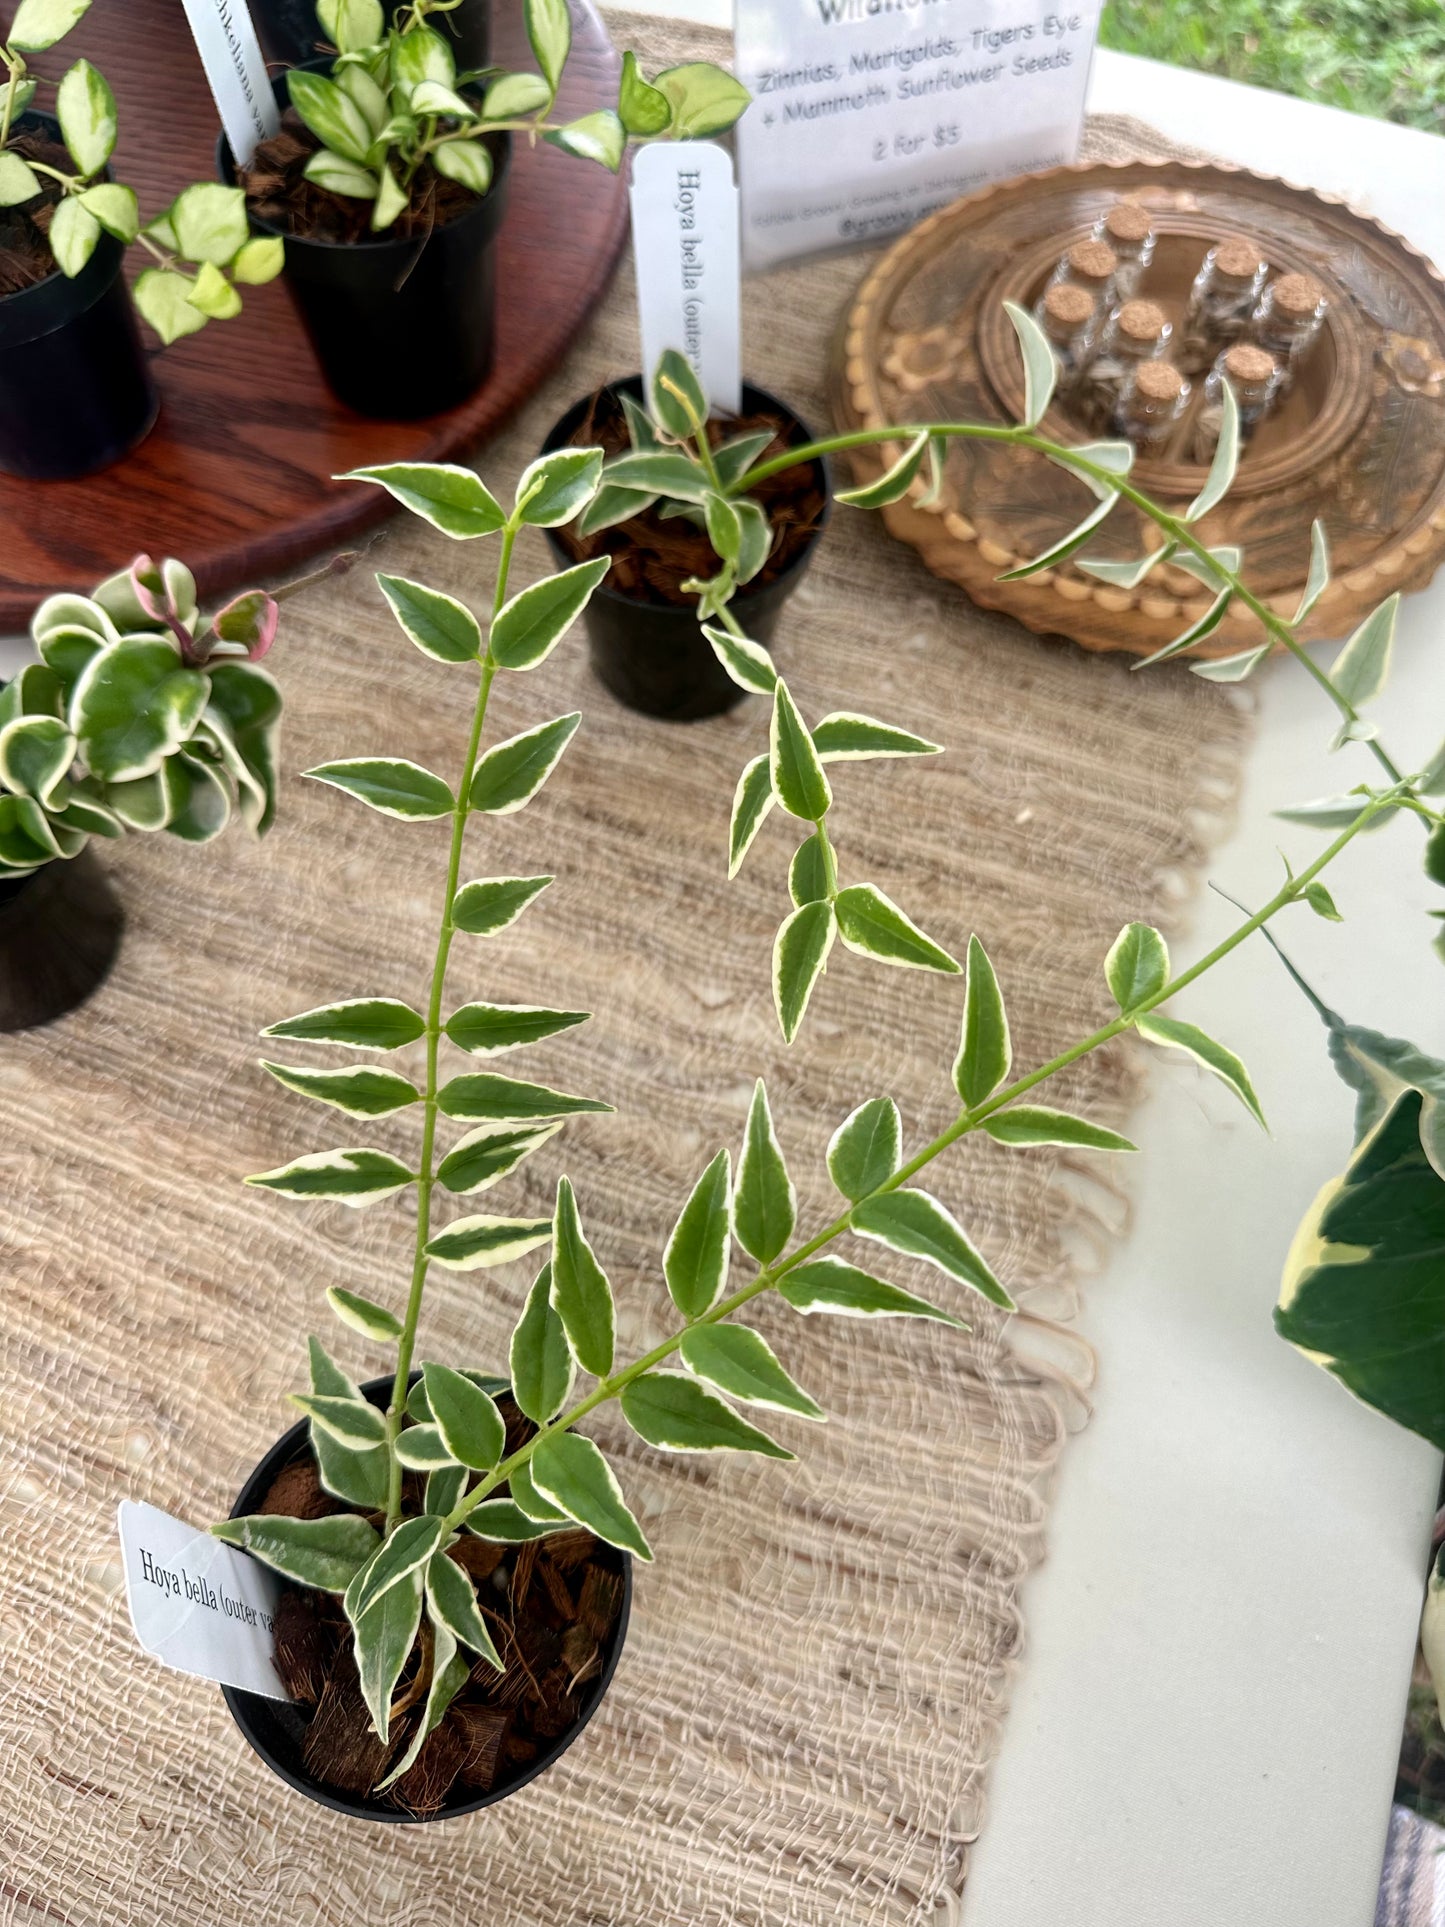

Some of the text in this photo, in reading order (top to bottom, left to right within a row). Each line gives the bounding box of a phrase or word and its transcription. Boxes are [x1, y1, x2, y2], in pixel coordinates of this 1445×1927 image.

[757, 13, 1082, 94] Zinnias, Marigolds, Tigers Eye
[762, 48, 1073, 128] + Mammoth Sunflower Seeds
[872, 139, 888, 161] 2
[933, 123, 962, 148] $5
[674, 169, 702, 230] Hoya
[681, 239, 704, 290] bella
[683, 297, 705, 359] (outer
[139, 1548, 182, 1598] Hoya
[182, 1568, 219, 1611] bella
[219, 1583, 257, 1627] (outer
